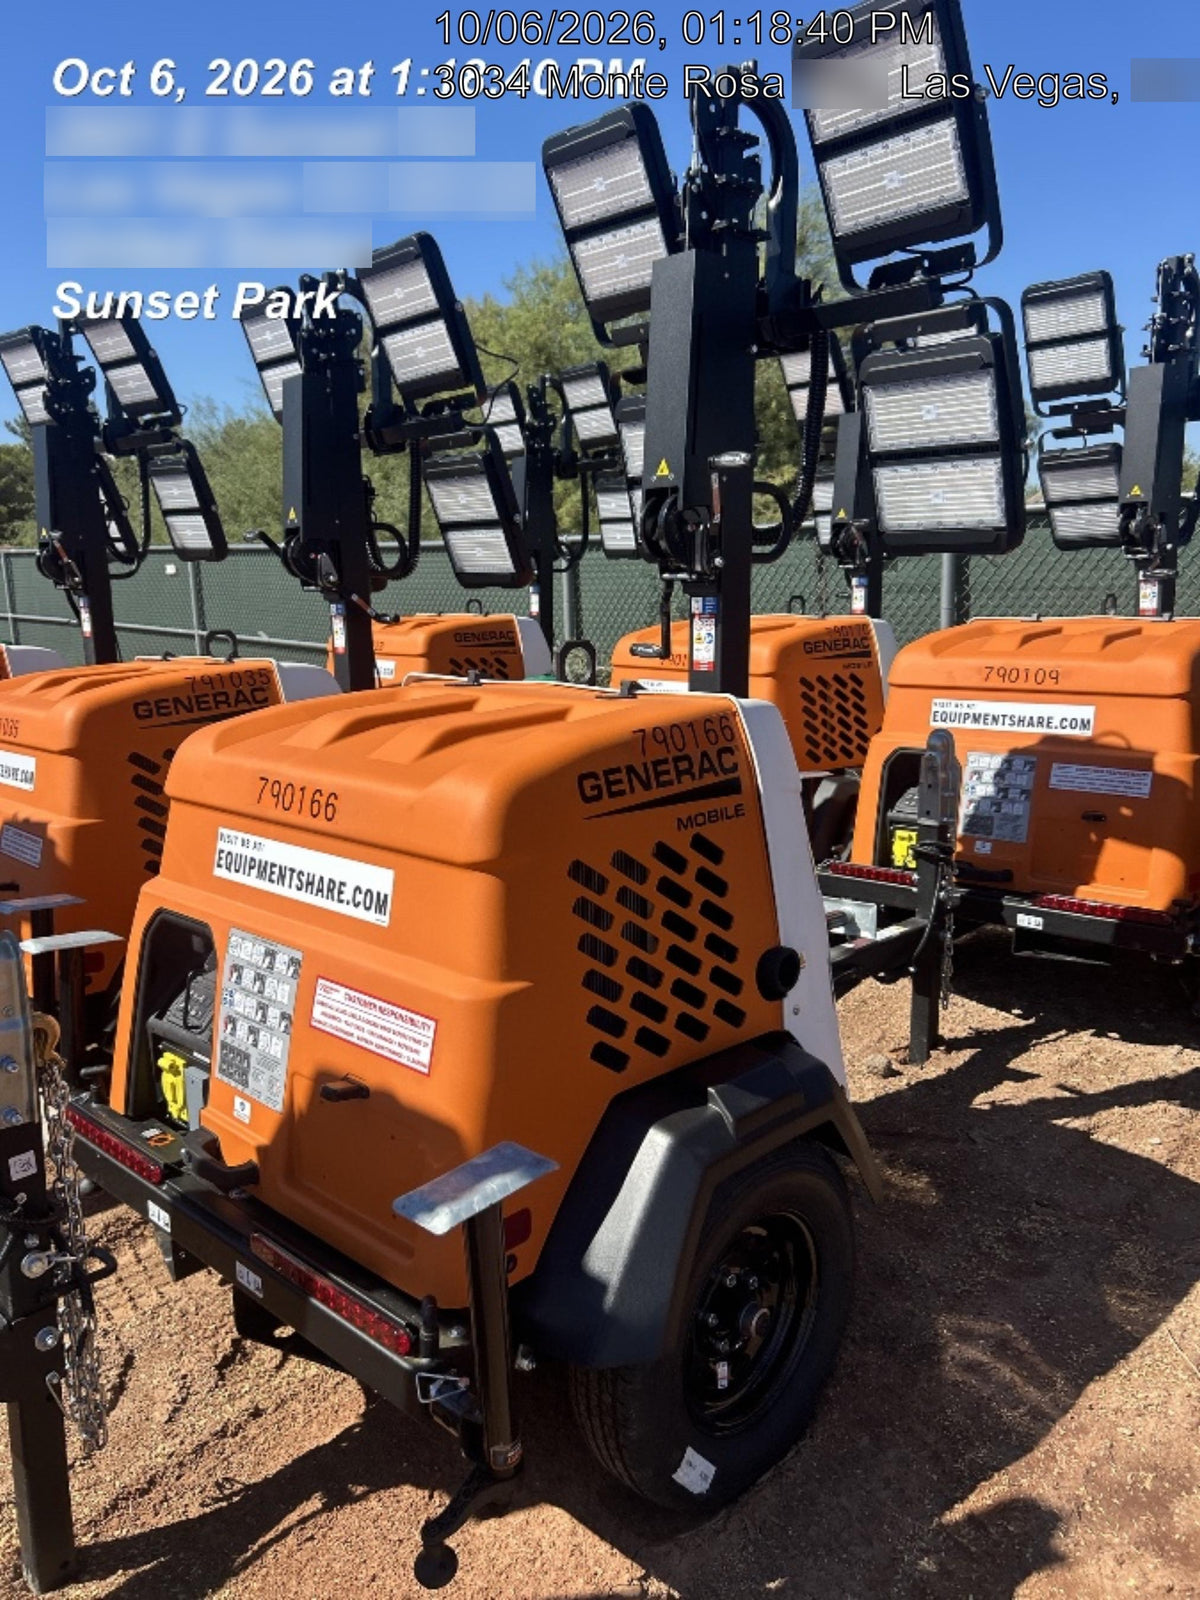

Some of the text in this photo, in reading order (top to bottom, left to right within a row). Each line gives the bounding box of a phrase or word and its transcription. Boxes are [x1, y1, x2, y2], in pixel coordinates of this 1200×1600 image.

[803, 636, 870, 655] GENERAC
[184, 668, 271, 693] 791035
[983, 666, 1061, 686] 790109
[132, 687, 269, 721] GENERAC
[632, 715, 736, 757] 790166
[932, 710, 1091, 732] EQUIPMENTSHARE.COM
[577, 746, 739, 804] GENERAC
[257, 776, 339, 822] 790166
[676, 803, 746, 832] MOBILE
[216, 848, 389, 917] EQUIPMENTSHARE.COM
